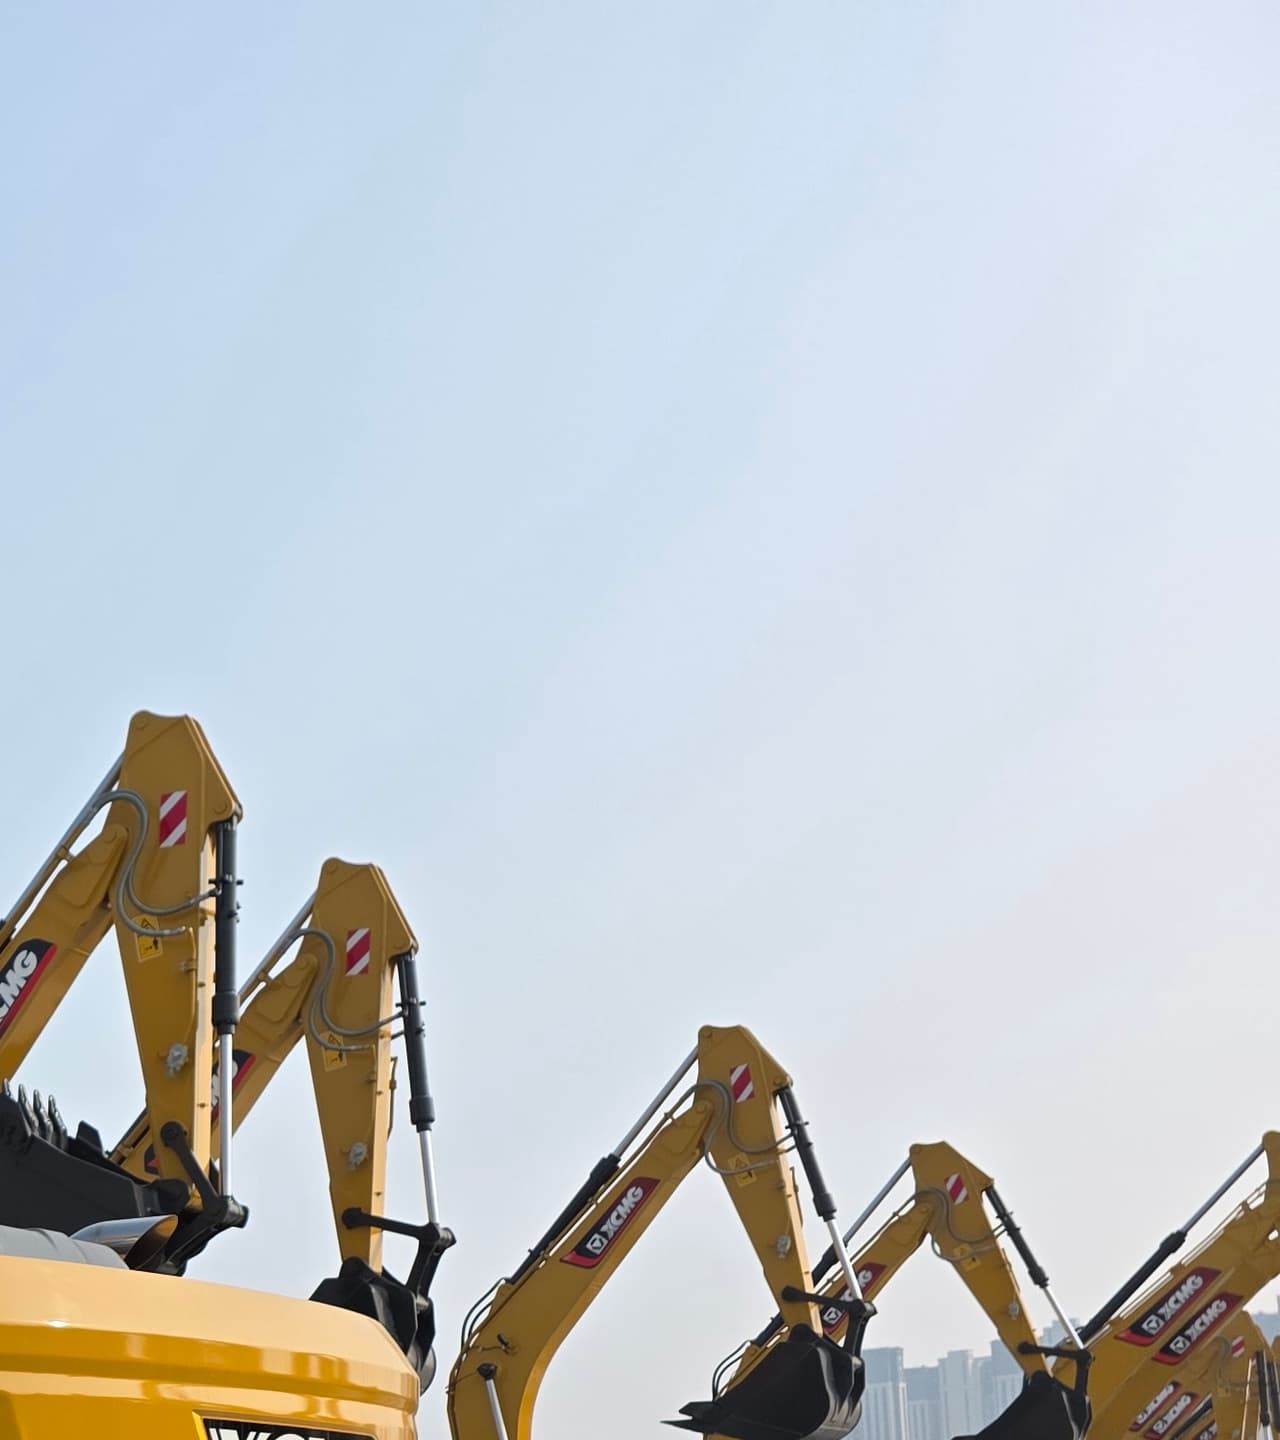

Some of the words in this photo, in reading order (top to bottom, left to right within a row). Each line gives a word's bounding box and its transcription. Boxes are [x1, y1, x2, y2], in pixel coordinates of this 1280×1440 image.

[600, 1186, 644, 1240] XCMG
[1158, 1275, 1203, 1322] XCMG
[1184, 1300, 1227, 1344] XCMG
